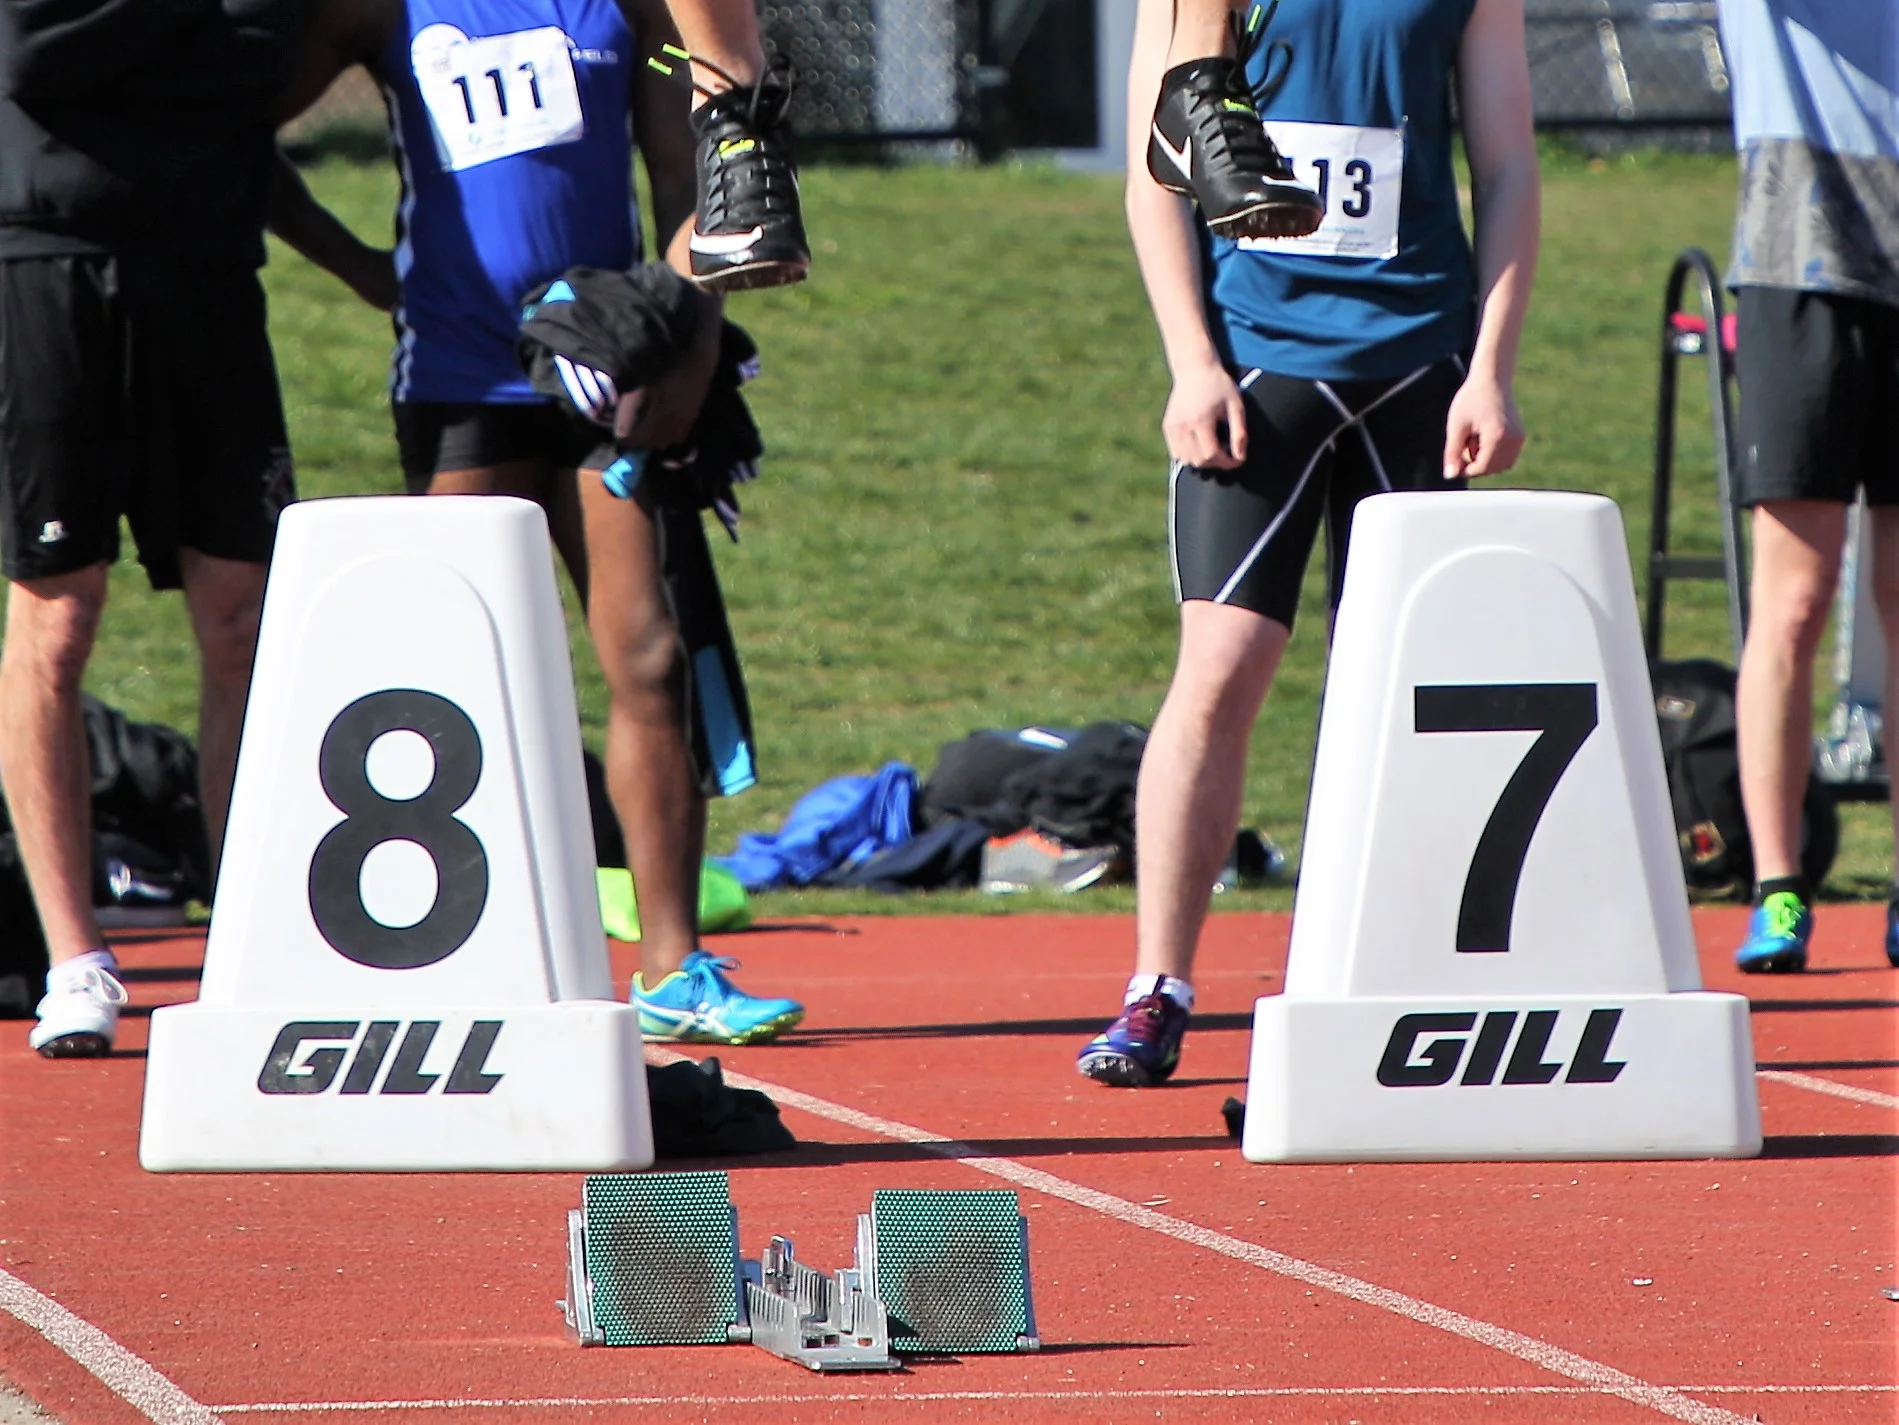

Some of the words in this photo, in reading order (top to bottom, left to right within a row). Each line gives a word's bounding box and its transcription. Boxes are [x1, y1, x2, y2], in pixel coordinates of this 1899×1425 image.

[452, 62, 543, 125] 111
[308, 688, 490, 970] 8
[1414, 682, 1599, 953] 7
[257, 1019, 508, 1095] GILL
[1376, 1008, 1628, 1088] GILL
